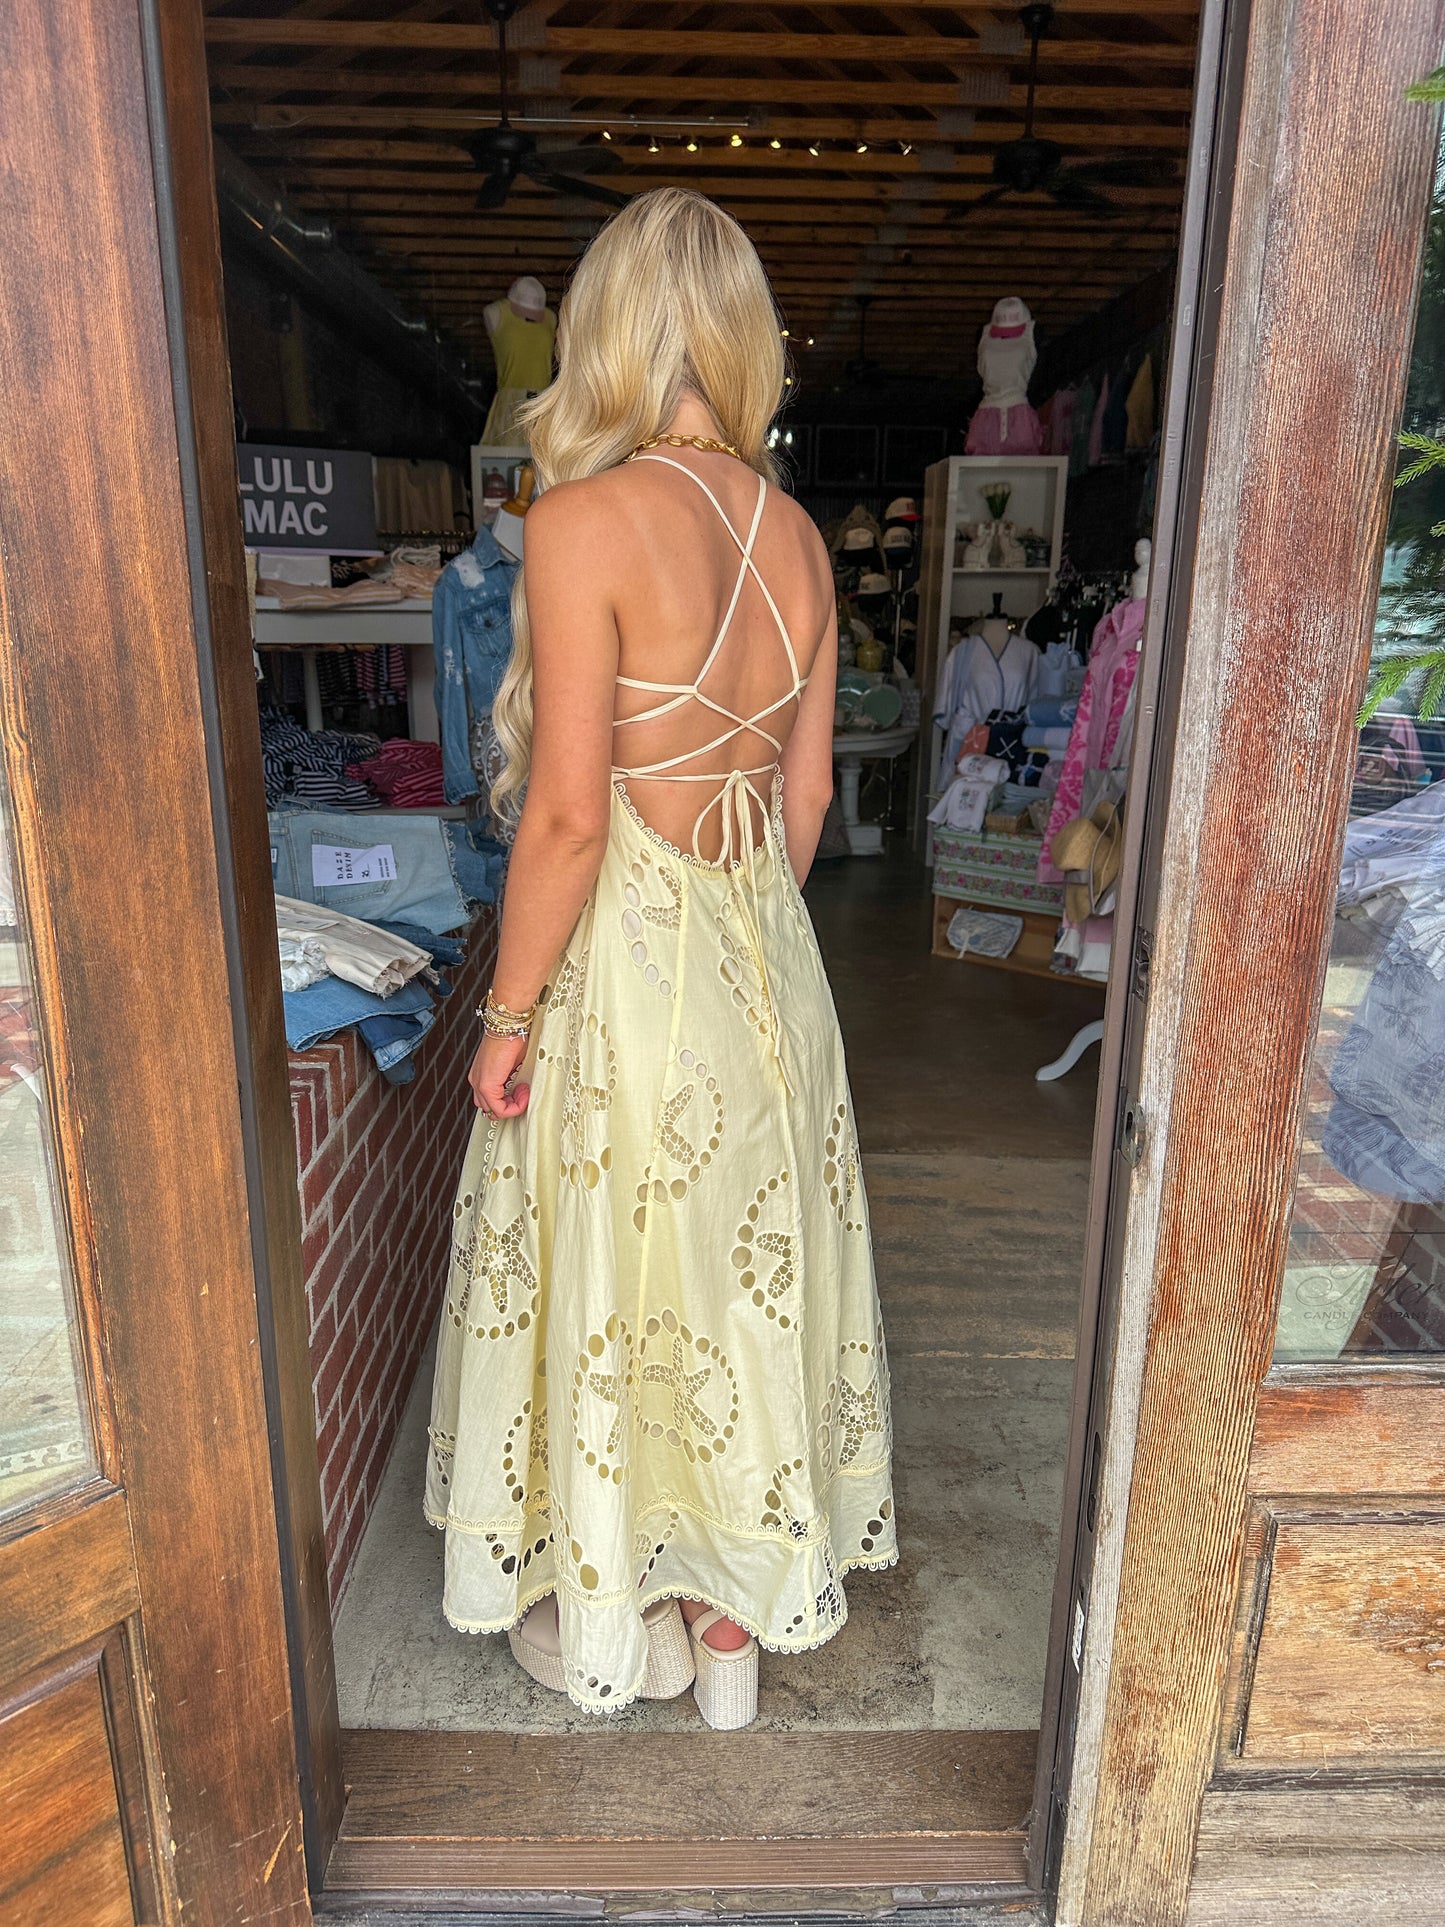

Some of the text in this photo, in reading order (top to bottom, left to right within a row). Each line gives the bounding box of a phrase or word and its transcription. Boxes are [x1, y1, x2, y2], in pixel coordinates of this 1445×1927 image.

[243, 499, 329, 536] MAC
[335, 851, 344, 880] DAZE
[344, 852, 353, 879] DENIM
